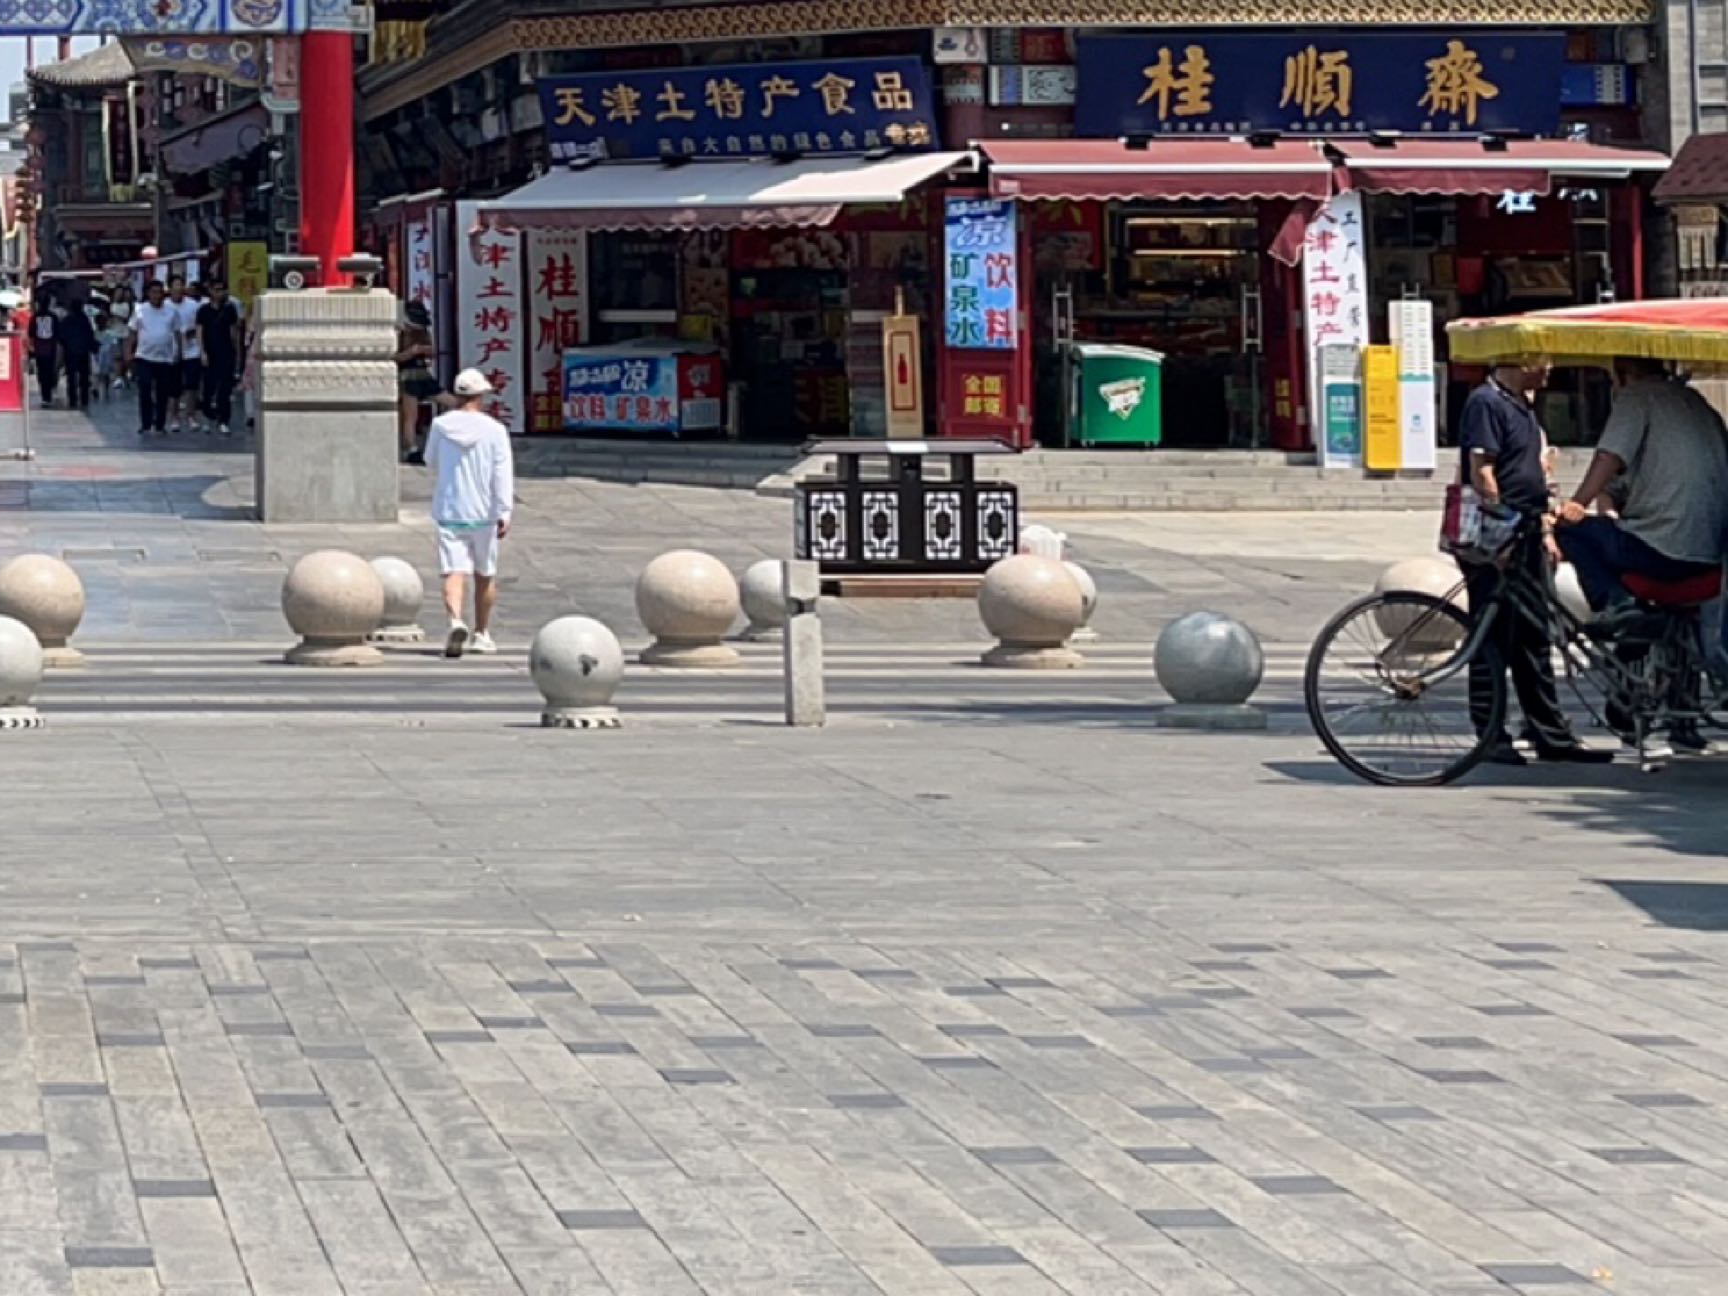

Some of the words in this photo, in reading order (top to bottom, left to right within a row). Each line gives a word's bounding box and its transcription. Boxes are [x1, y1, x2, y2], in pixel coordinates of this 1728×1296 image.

[553, 71, 914, 126] 天津土特产食品
[950, 252, 982, 346] 矿泉水
[984, 252, 1014, 344] 饮料
